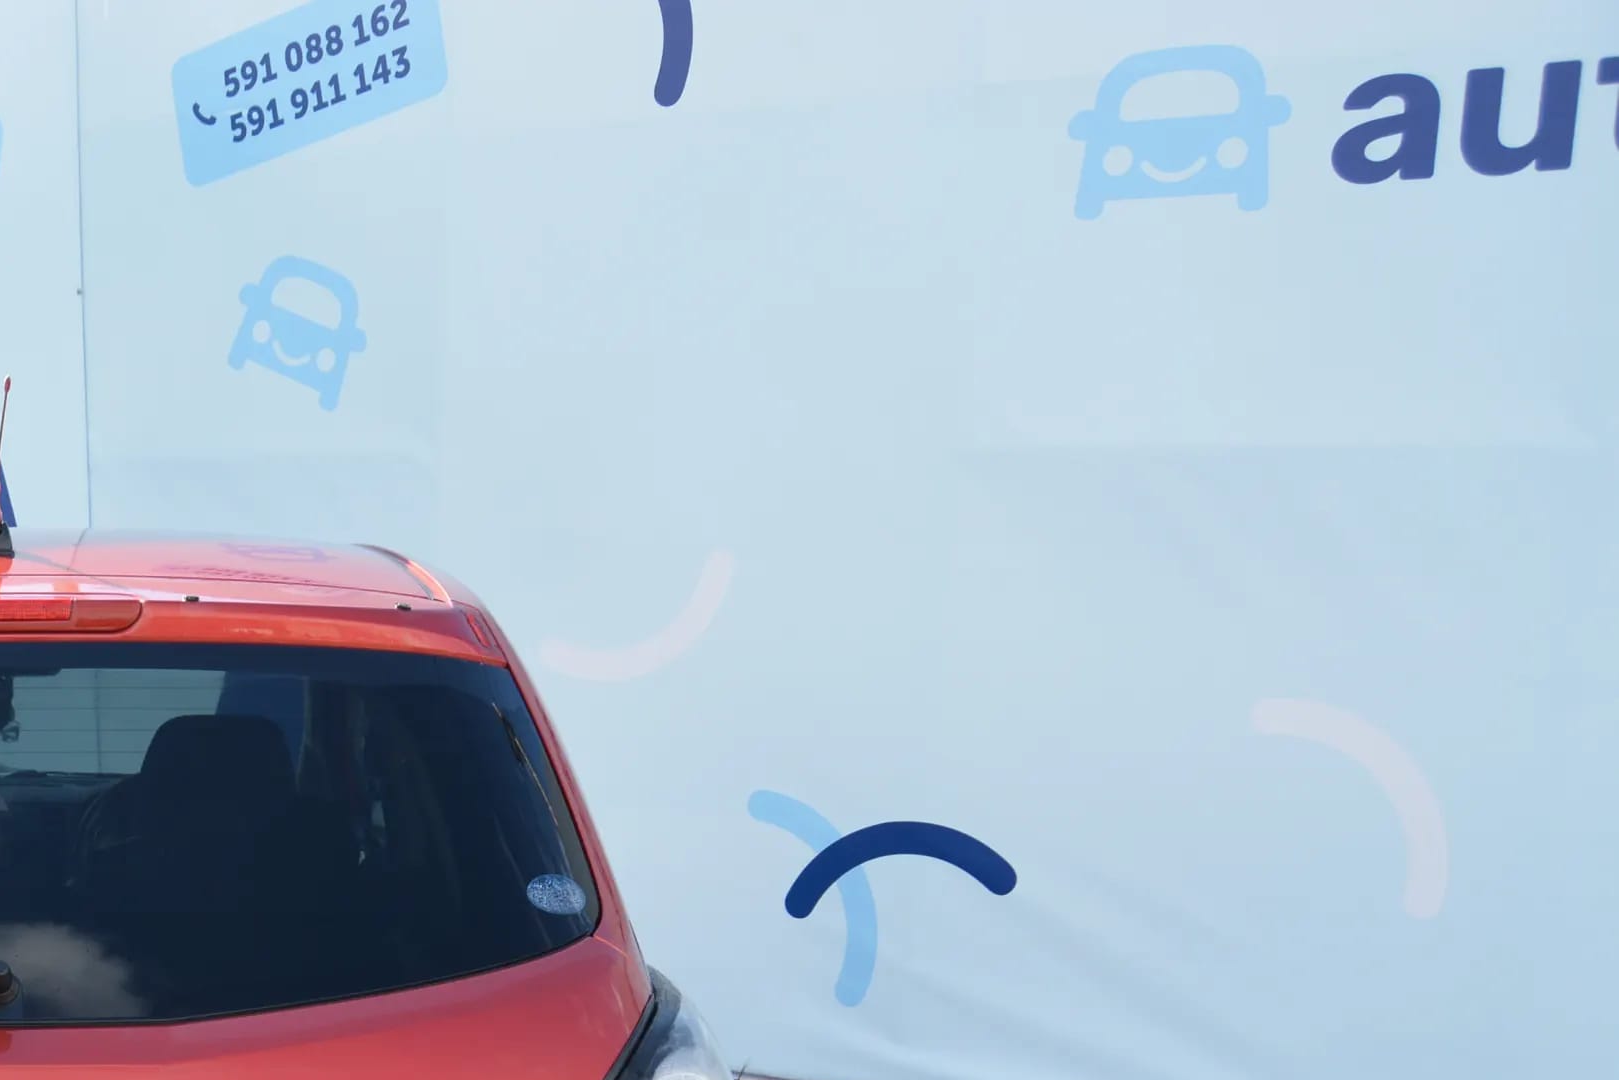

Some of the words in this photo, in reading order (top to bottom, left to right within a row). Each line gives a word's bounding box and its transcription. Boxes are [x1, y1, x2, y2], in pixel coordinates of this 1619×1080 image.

[223, 52, 278, 98] 591
[284, 24, 344, 73] 088
[351, 0, 411, 47] 162
[229, 97, 285, 144] 591
[290, 73, 347, 120] 911
[352, 44, 412, 96] 143
